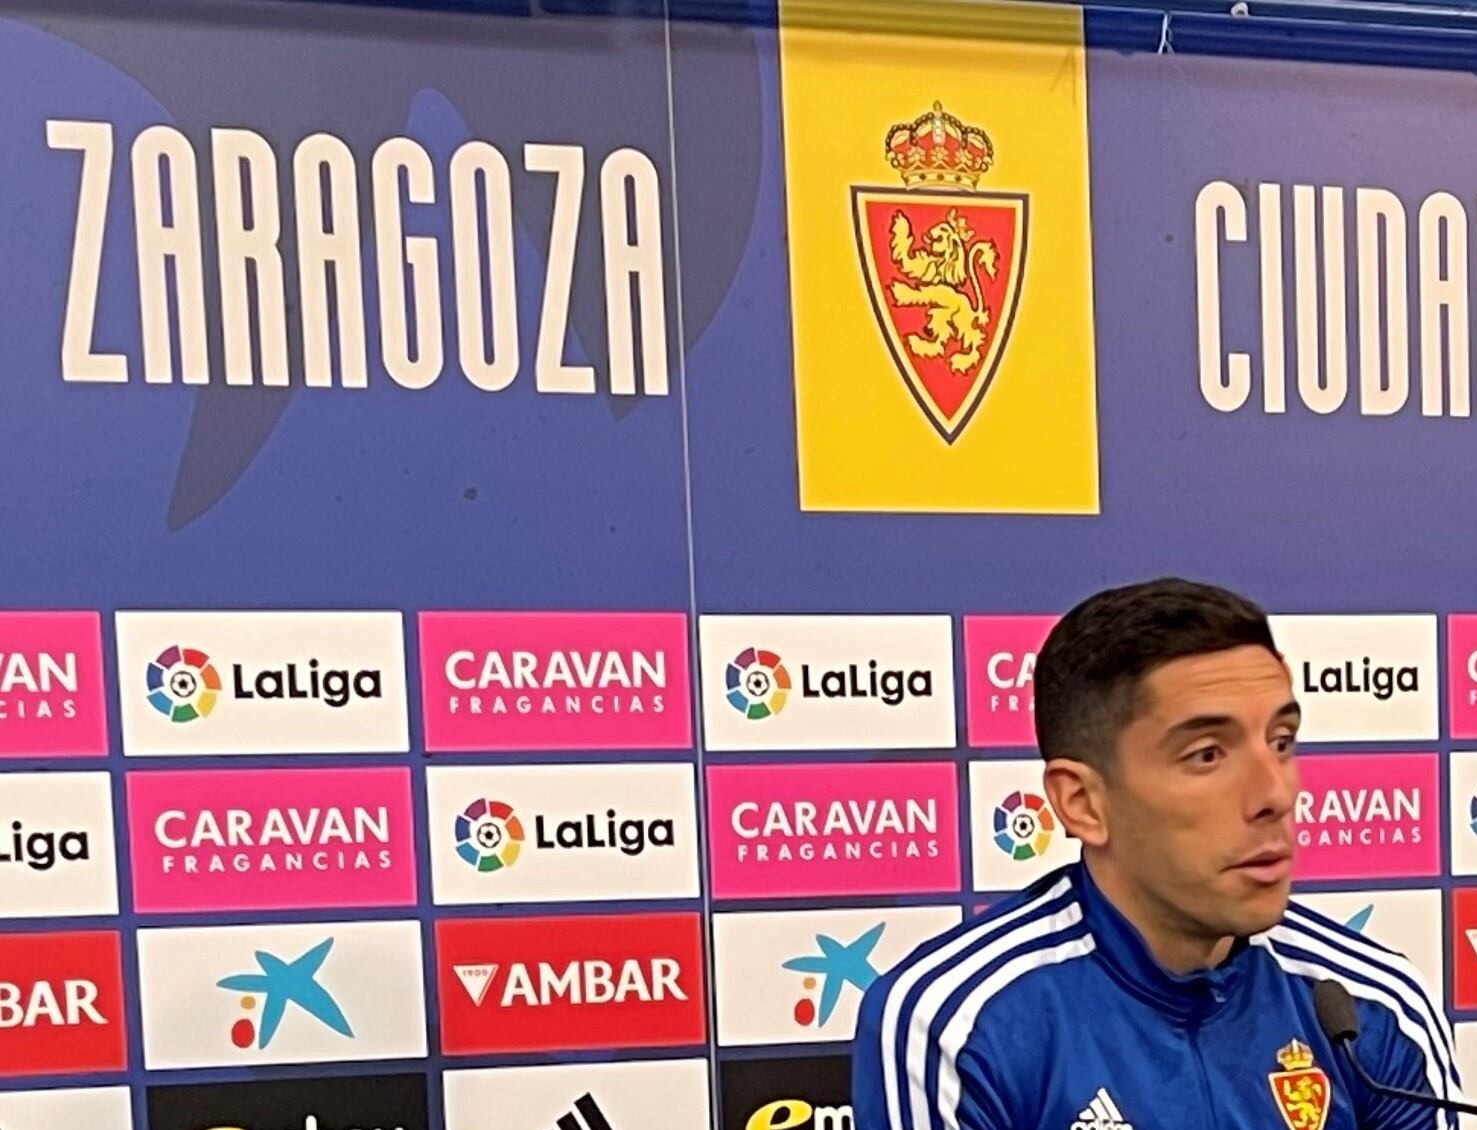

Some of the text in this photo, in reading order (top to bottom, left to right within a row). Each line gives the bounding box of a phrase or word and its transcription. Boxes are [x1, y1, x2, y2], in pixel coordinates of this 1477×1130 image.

[45, 119, 669, 397] ZARAGOZA
[232, 658, 382, 708] LaLiga
[445, 650, 666, 690] CARAVAN
[801, 659, 933, 706] LaLiga
[1303, 656, 1419, 700] LaLiga
[449, 695, 665, 714] FRAGANCIAS
[154, 806, 389, 849] CARAVAN
[535, 808, 675, 857] LaLiga
[731, 799, 937, 839] CARAVAN
[162, 850, 391, 873] FRAGANCIAS
[737, 839, 939, 862] FRAGANCIAS
[500, 958, 688, 1007] AMBAR
